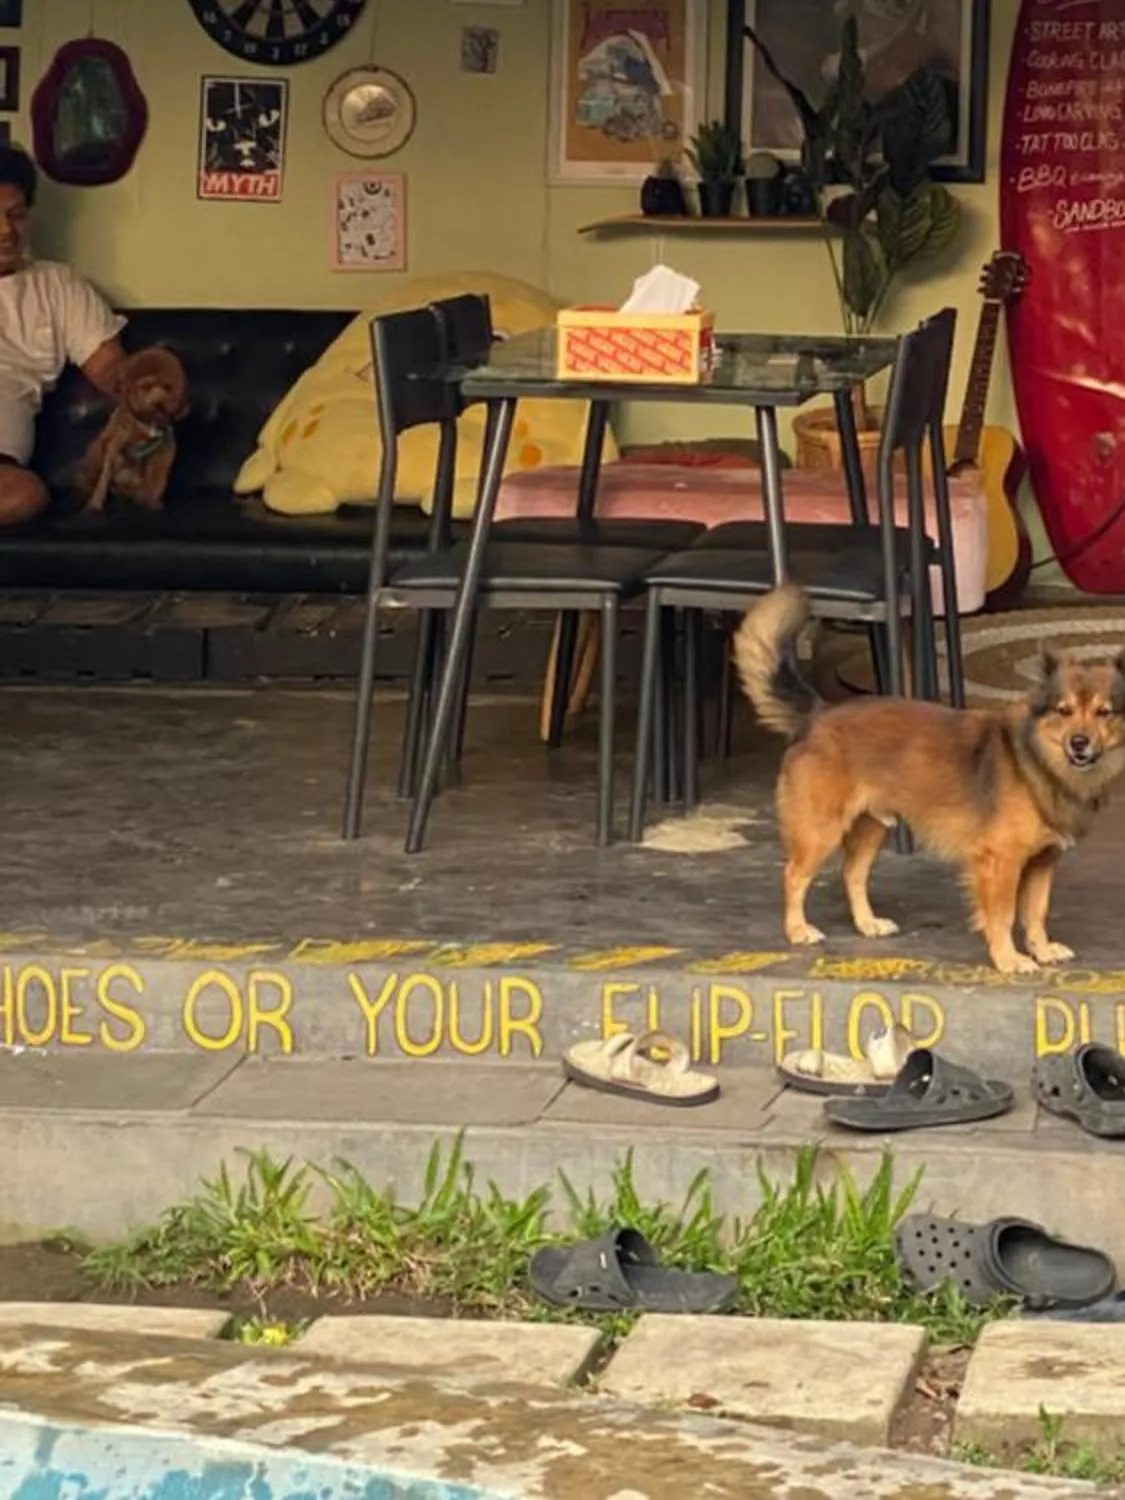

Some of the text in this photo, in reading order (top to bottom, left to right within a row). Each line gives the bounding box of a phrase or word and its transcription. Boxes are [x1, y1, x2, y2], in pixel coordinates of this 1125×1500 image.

[1028, 20, 1098, 43] STREET
[205, 174, 276, 195] MYTH
[1016, 163, 1068, 193] BBQ
[182, 968, 293, 1054] OR
[348, 971, 543, 1058] YOUR
